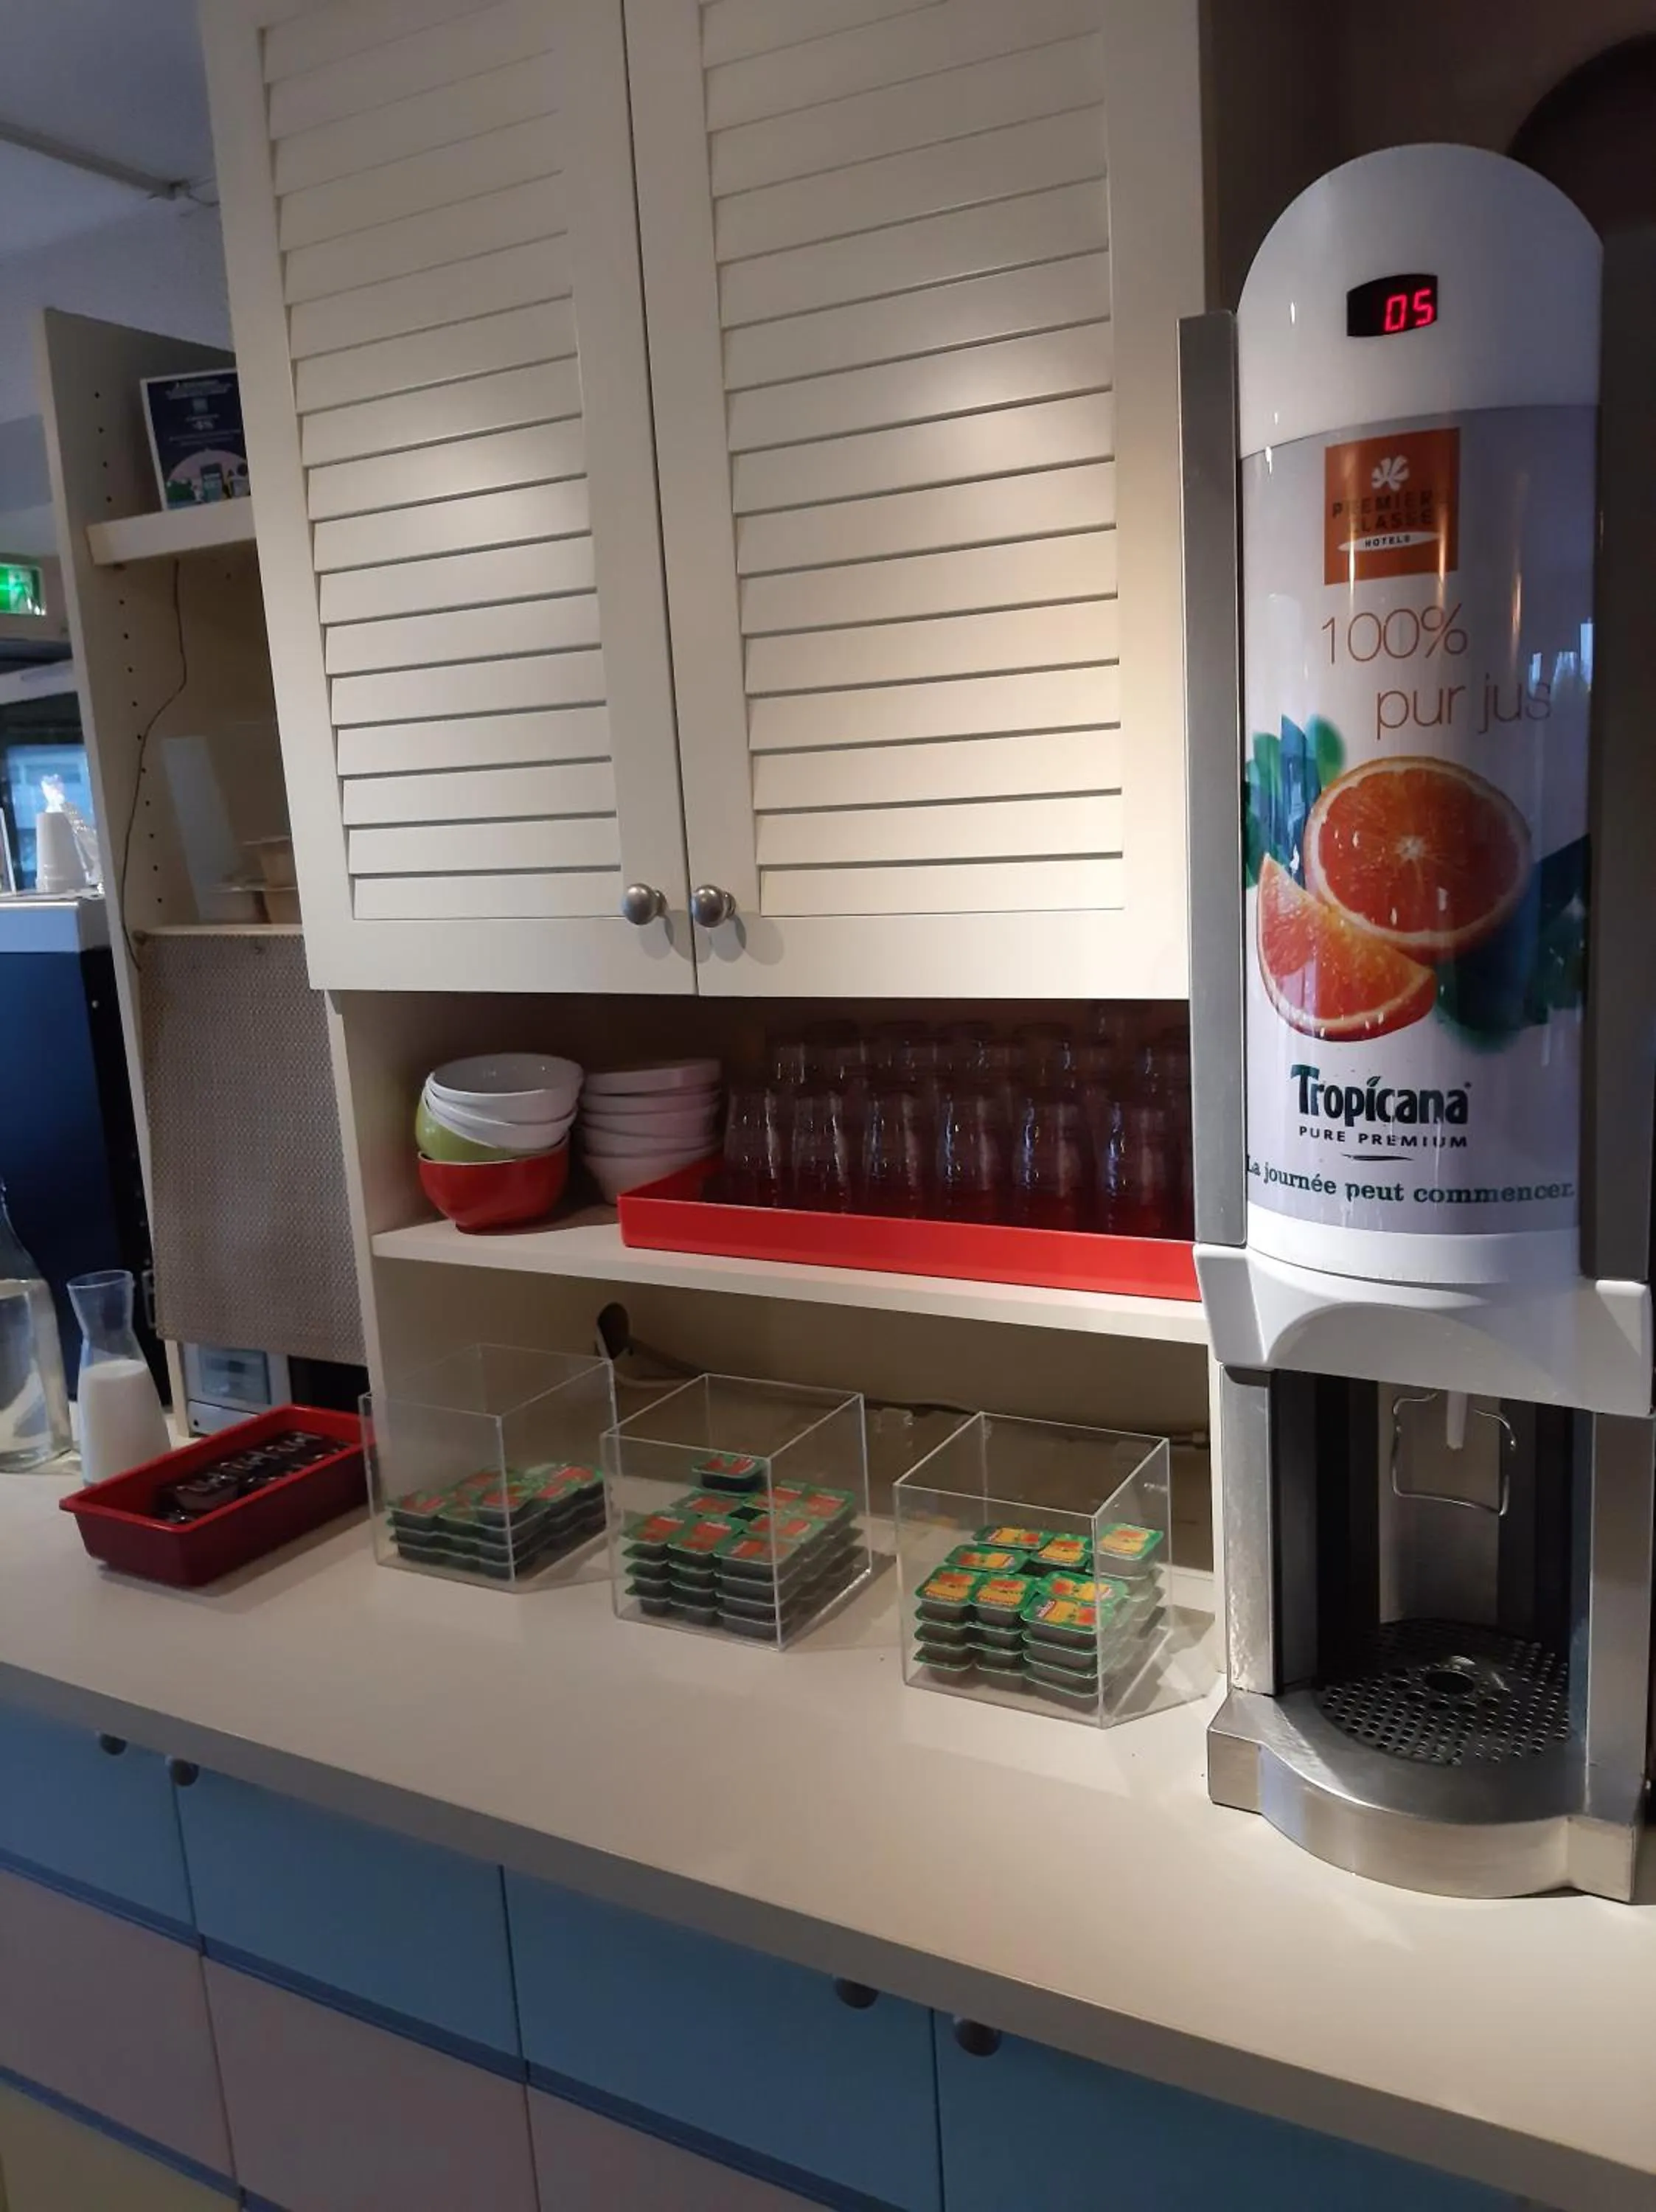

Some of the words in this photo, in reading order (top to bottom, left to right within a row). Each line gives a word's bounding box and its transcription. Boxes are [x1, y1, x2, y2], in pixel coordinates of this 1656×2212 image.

[1384, 288, 1434, 332] 05
[1332, 489, 1447, 519] PEMIER
[1349, 508, 1435, 535] LASSE
[1365, 535, 1411, 547] HOTELS
[1321, 603, 1468, 664] 100%
[1377, 684, 1467, 740] pur
[1478, 672, 1551, 734] jus
[1299, 1126, 1346, 1142] PURE
[1358, 1133, 1467, 1148] PREMIUM
[1264, 1162, 1337, 1194] journée
[1345, 1182, 1405, 1202] peut
